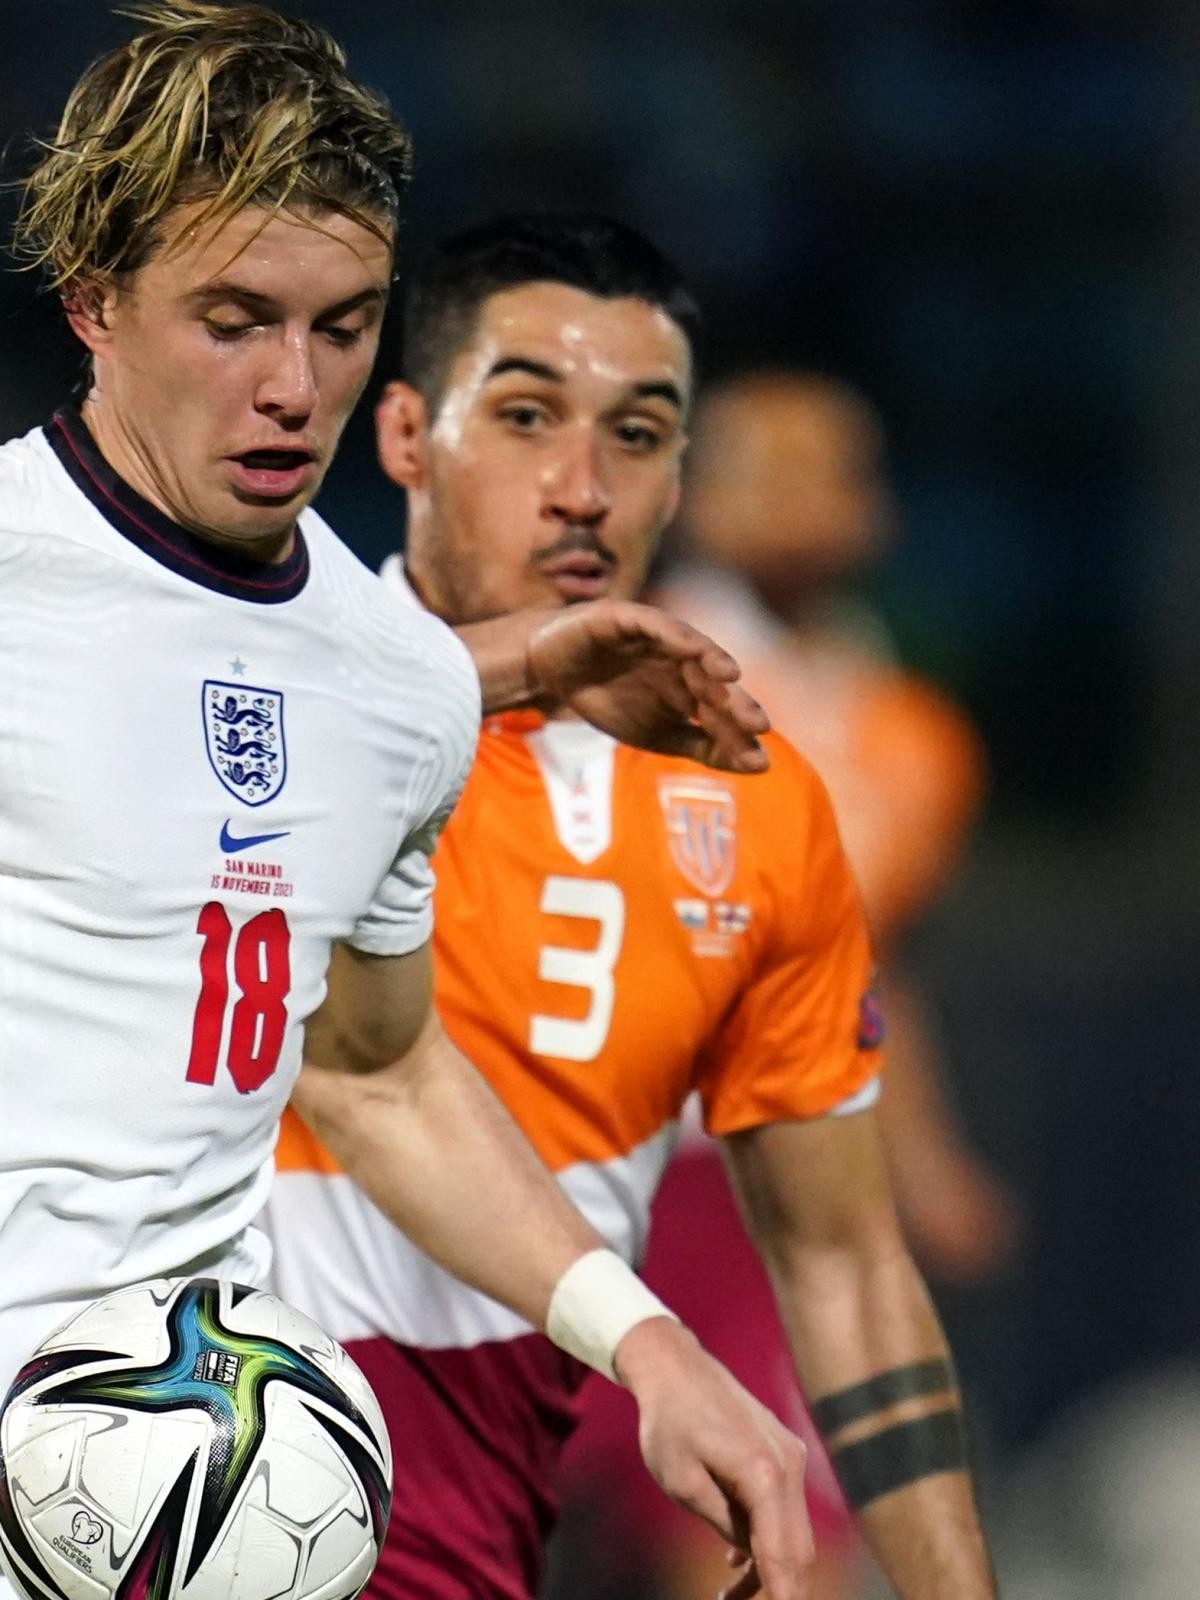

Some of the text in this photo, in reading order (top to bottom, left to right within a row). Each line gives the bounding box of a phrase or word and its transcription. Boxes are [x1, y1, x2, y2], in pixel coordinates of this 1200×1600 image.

[225, 859, 282, 879] SAN MARINO
[210, 874, 293, 897] 15 NOVEMBER 2021
[529, 875, 626, 1063] 3
[185, 901, 291, 1095] 18
[216, 1353, 227, 1381] QUALITY
[223, 1355, 239, 1382] FIFA
[52, 1537, 93, 1574] QUALIFIERS
[59, 1534, 92, 1564] EUROPEAN
